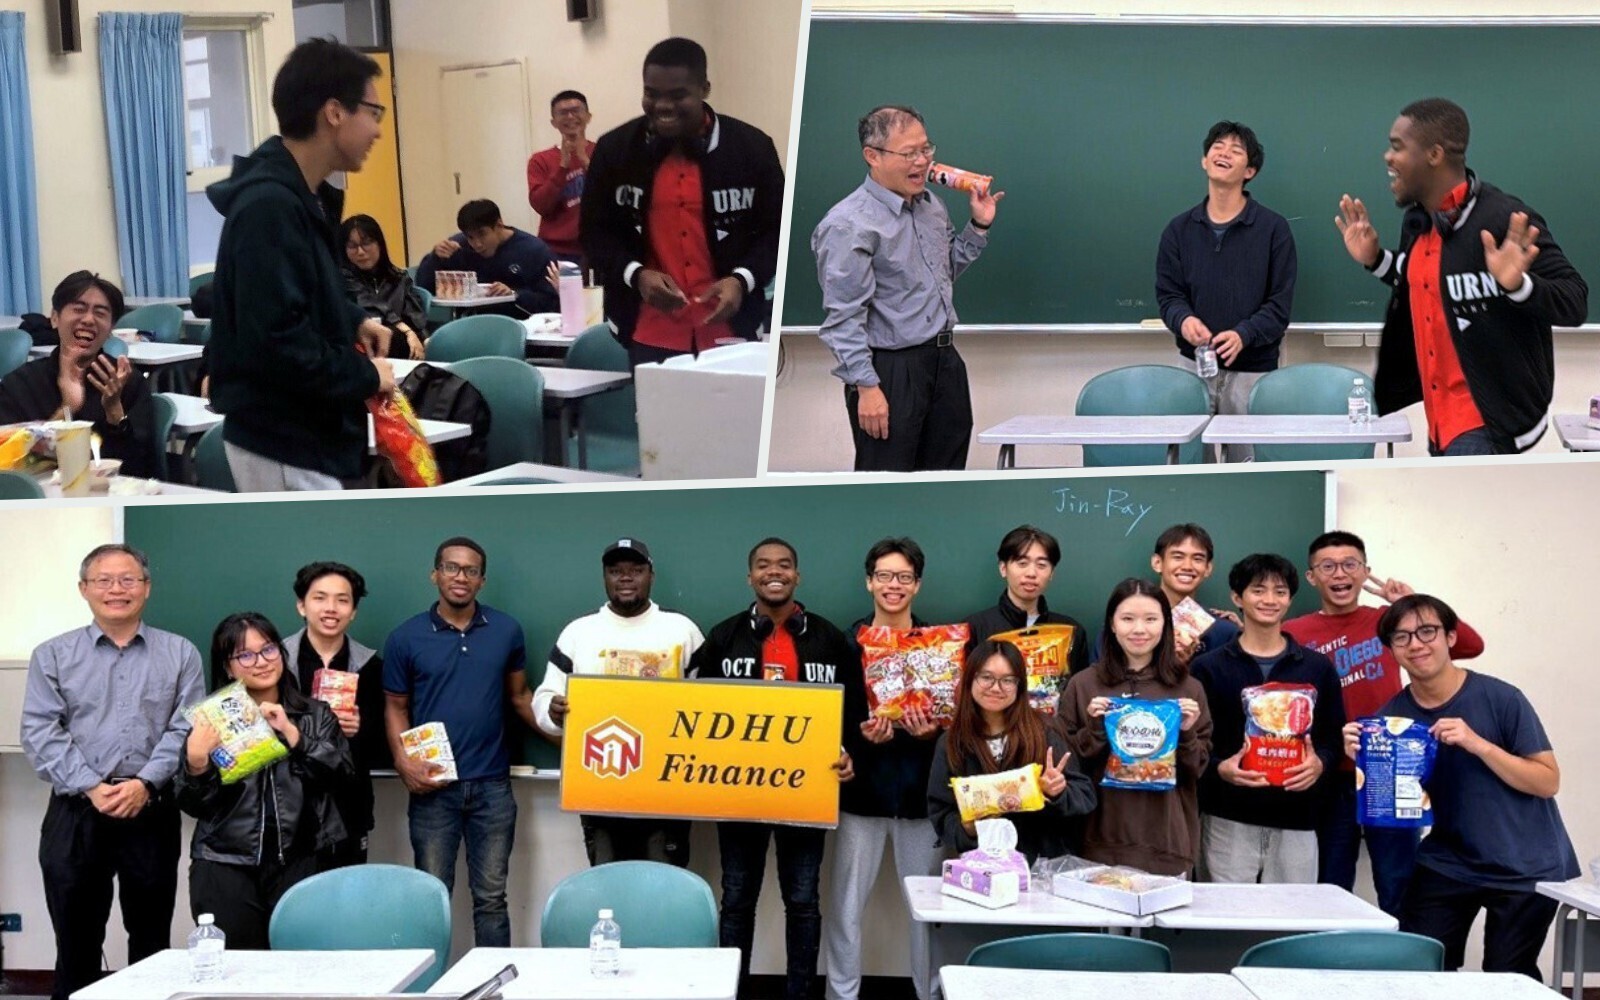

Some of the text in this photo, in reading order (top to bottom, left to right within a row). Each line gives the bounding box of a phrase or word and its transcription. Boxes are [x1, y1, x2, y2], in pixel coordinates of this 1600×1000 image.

[712, 187, 756, 214] URN
[1445, 271, 1505, 301] URN
[1053, 488, 1153, 537] Jin-Ray
[721, 658, 755, 677] OCT
[1334, 636, 1384, 677] DIEGO
[805, 663, 837, 684] URN
[669, 710, 812, 744] NDHU
[657, 753, 806, 789] Finance
